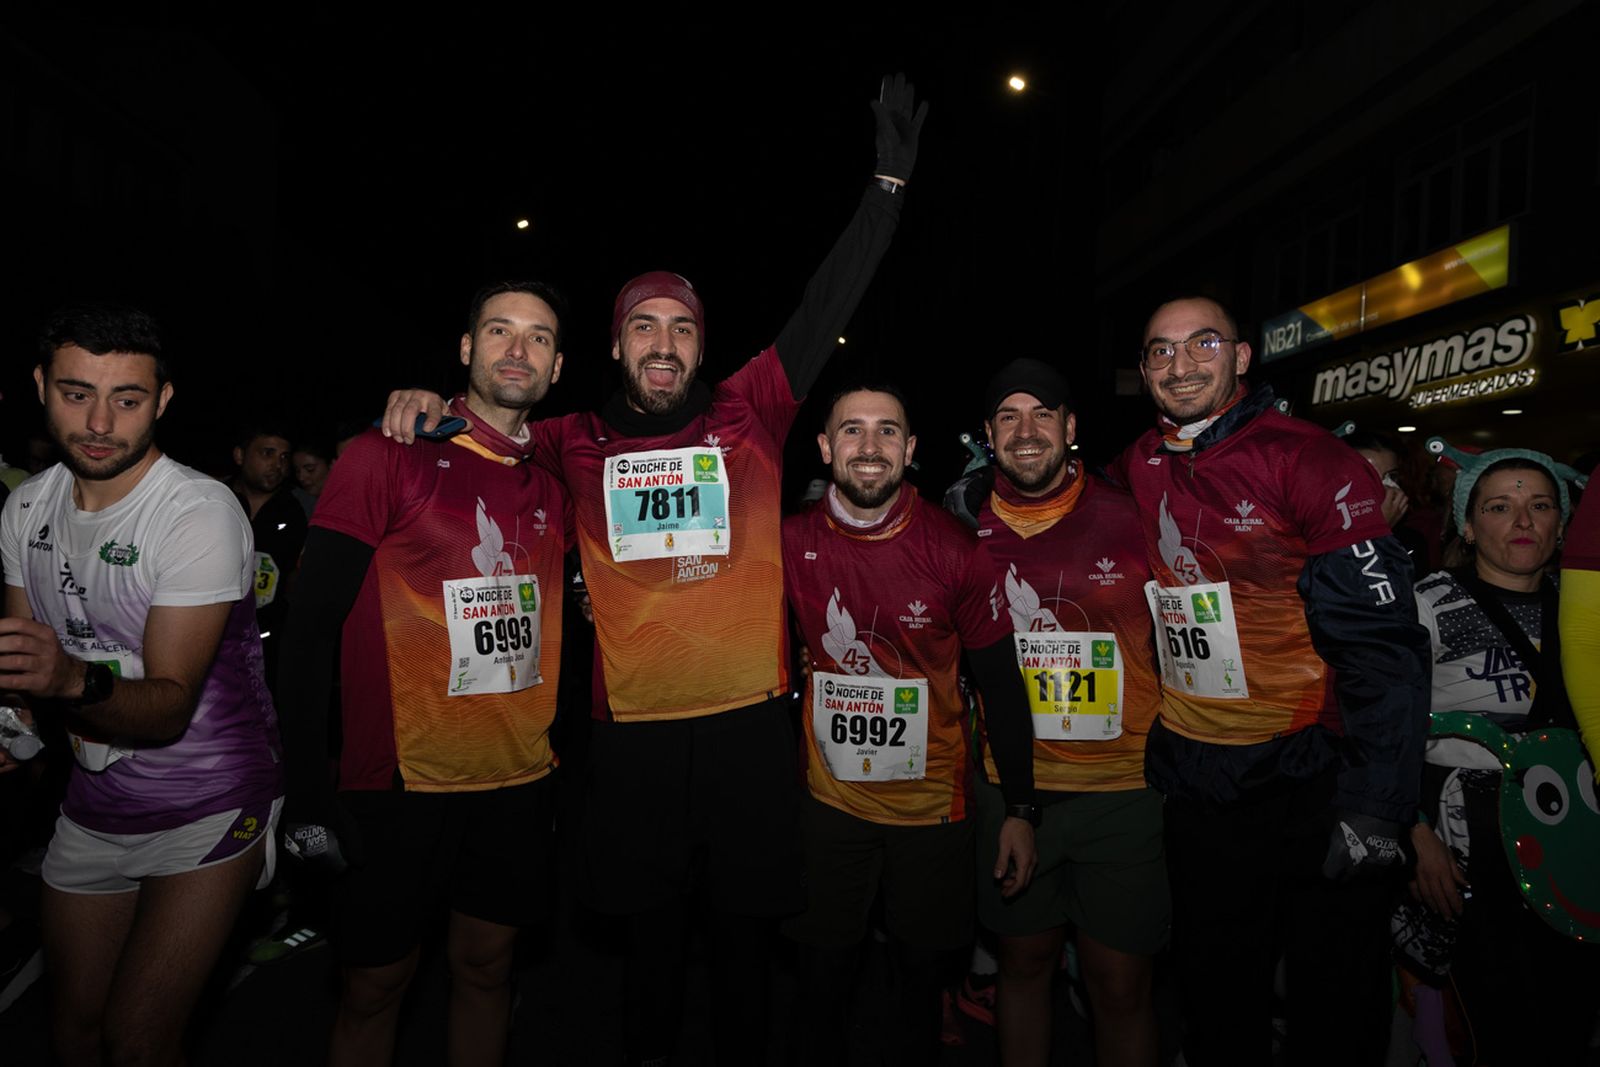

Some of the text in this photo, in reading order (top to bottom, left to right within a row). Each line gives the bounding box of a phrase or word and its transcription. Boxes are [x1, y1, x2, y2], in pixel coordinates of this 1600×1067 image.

[1264, 320, 1302, 356] NB21
[1311, 314, 1538, 405] masymas
[1408, 367, 1537, 409] SUPERMERCADOS
[632, 462, 666, 474] NOCHE
[669, 460, 682, 471] DE
[618, 476, 642, 488] SAN
[644, 471, 683, 487] ANTÓN
[635, 486, 701, 521] 7811
[657, 522, 679, 530] Jaime
[677, 555, 702, 567] SAN
[678, 562, 718, 579] ANTÓN
[1174, 555, 1198, 585] 43
[477, 590, 512, 603] NOCHE DE
[1172, 600, 1183, 610] DE
[463, 606, 488, 619] SAN
[490, 602, 515, 616] ANTÓN
[474, 616, 532, 655] 6993
[1030, 644, 1080, 655] NOCHE DE
[842, 648, 870, 675] 43
[1042, 655, 1080, 668] ANTÓN
[836, 687, 868, 700] NOCHE
[870, 690, 884, 701] DE
[1034, 671, 1095, 702] 1121
[825, 698, 844, 712] SAN
[846, 701, 884, 713] ANTÓN
[831, 713, 907, 746] 6992
[856, 748, 877, 756] Javier
